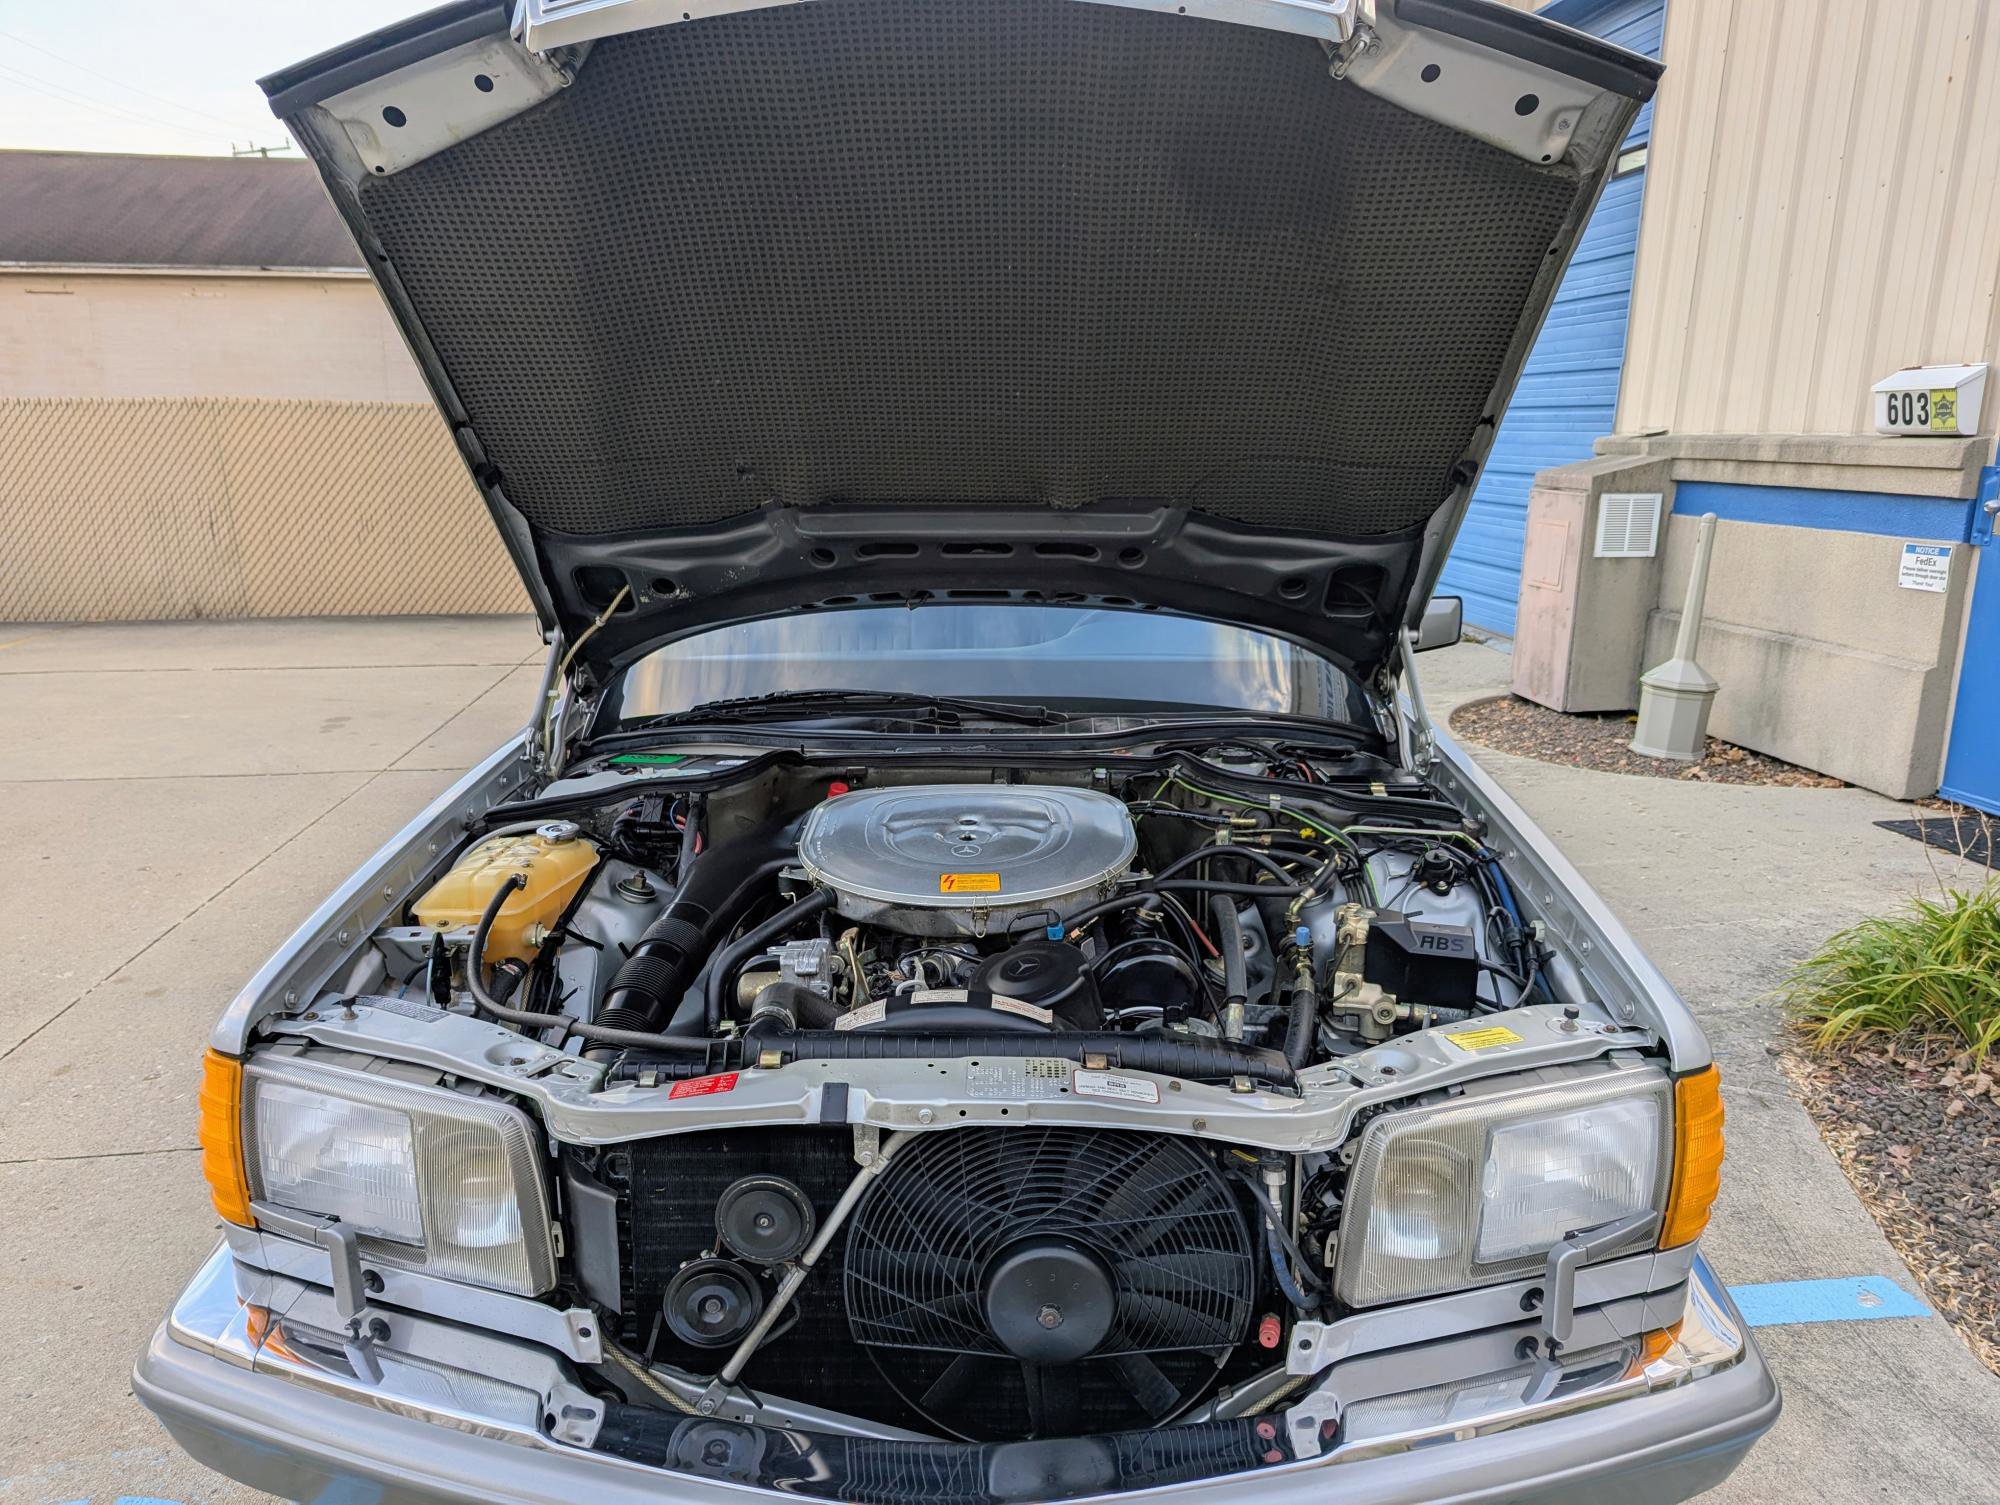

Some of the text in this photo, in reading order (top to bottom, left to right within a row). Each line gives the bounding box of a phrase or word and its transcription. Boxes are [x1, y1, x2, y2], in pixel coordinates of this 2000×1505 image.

[1888, 392, 1929, 426] 603
[1915, 546, 1940, 555] NOTICE
[1915, 556, 1937, 567] FedEx
[1420, 935, 1465, 952] ABS
